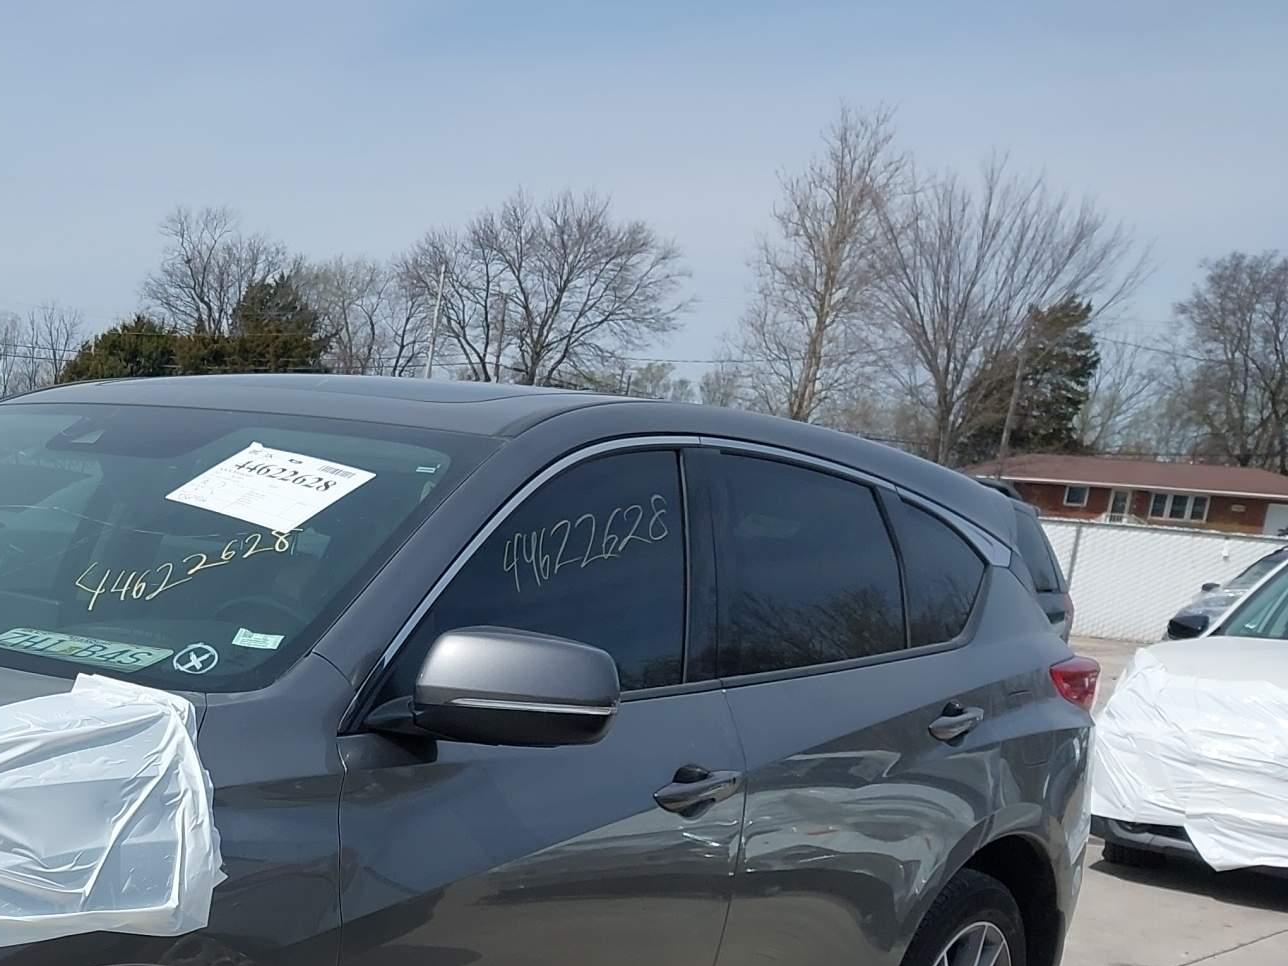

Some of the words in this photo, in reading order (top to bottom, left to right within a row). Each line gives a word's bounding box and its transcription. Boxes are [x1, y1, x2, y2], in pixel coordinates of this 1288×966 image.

[234, 460, 337, 492] 44622628
[74, 528, 301, 611] 44622628
[502, 494, 668, 593] 44622628
